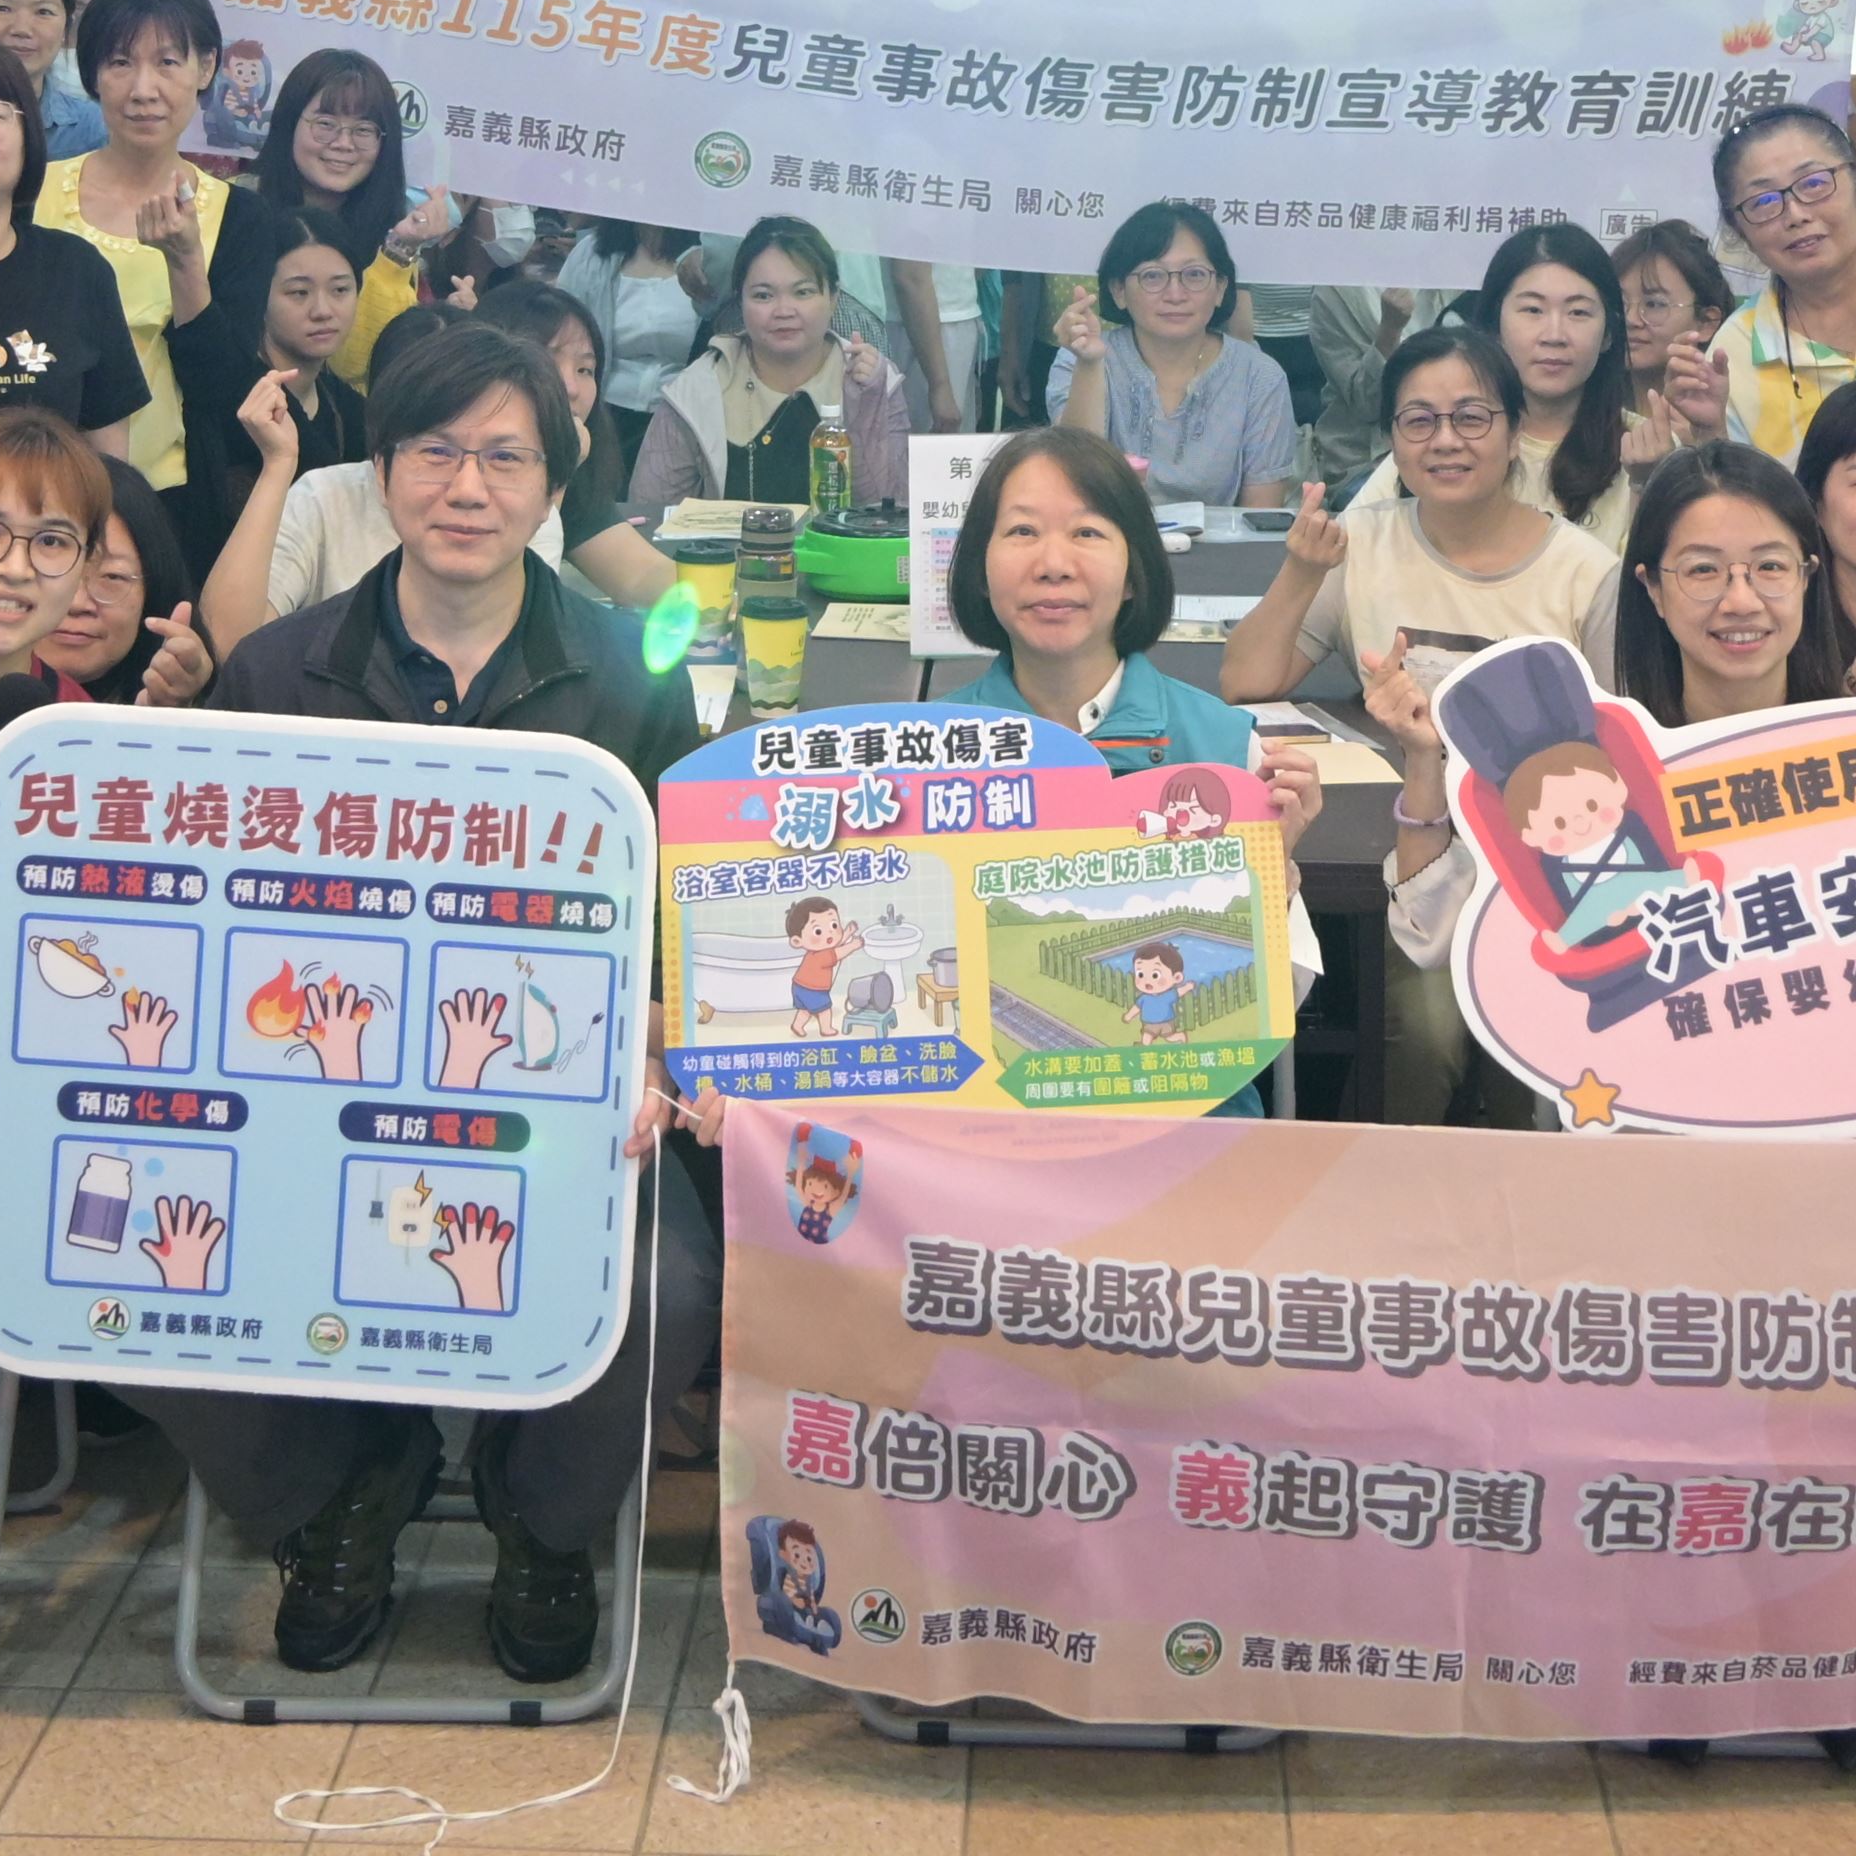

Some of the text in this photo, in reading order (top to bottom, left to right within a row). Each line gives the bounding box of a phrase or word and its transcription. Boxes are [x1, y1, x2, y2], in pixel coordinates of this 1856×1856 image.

[444, 104, 626, 162] 嘉義縣政府
[769, 154, 992, 213] 嘉義縣衛生局
[1015, 186, 1106, 219] 關心您
[14, 373, 37, 385] Life
[757, 722, 1028, 771] 兒童事故傷害
[21, 863, 206, 901] 預防熱液燙傷
[675, 847, 908, 900] 浴室容器不儲水
[976, 838, 1243, 896] 庭院水池防護措施
[231, 875, 413, 914] 預防火焰燒傷
[431, 890, 614, 928] 預防電器燒傷
[75, 1090, 231, 1126] 預防化學傷
[373, 1111, 498, 1147] 預防電傷
[139, 1310, 494, 1357] 嘉義縣政府 嘉義縣衛生局
[785, 1393, 1128, 1519] 嘉倍關心
[1174, 1446, 1537, 1550] 義起守護
[920, 1607, 1098, 1665] 嘉義縣政府
[1241, 1636, 1465, 1684] 嘉義縣衛生局
[1485, 1657, 1578, 1687] 關心您
